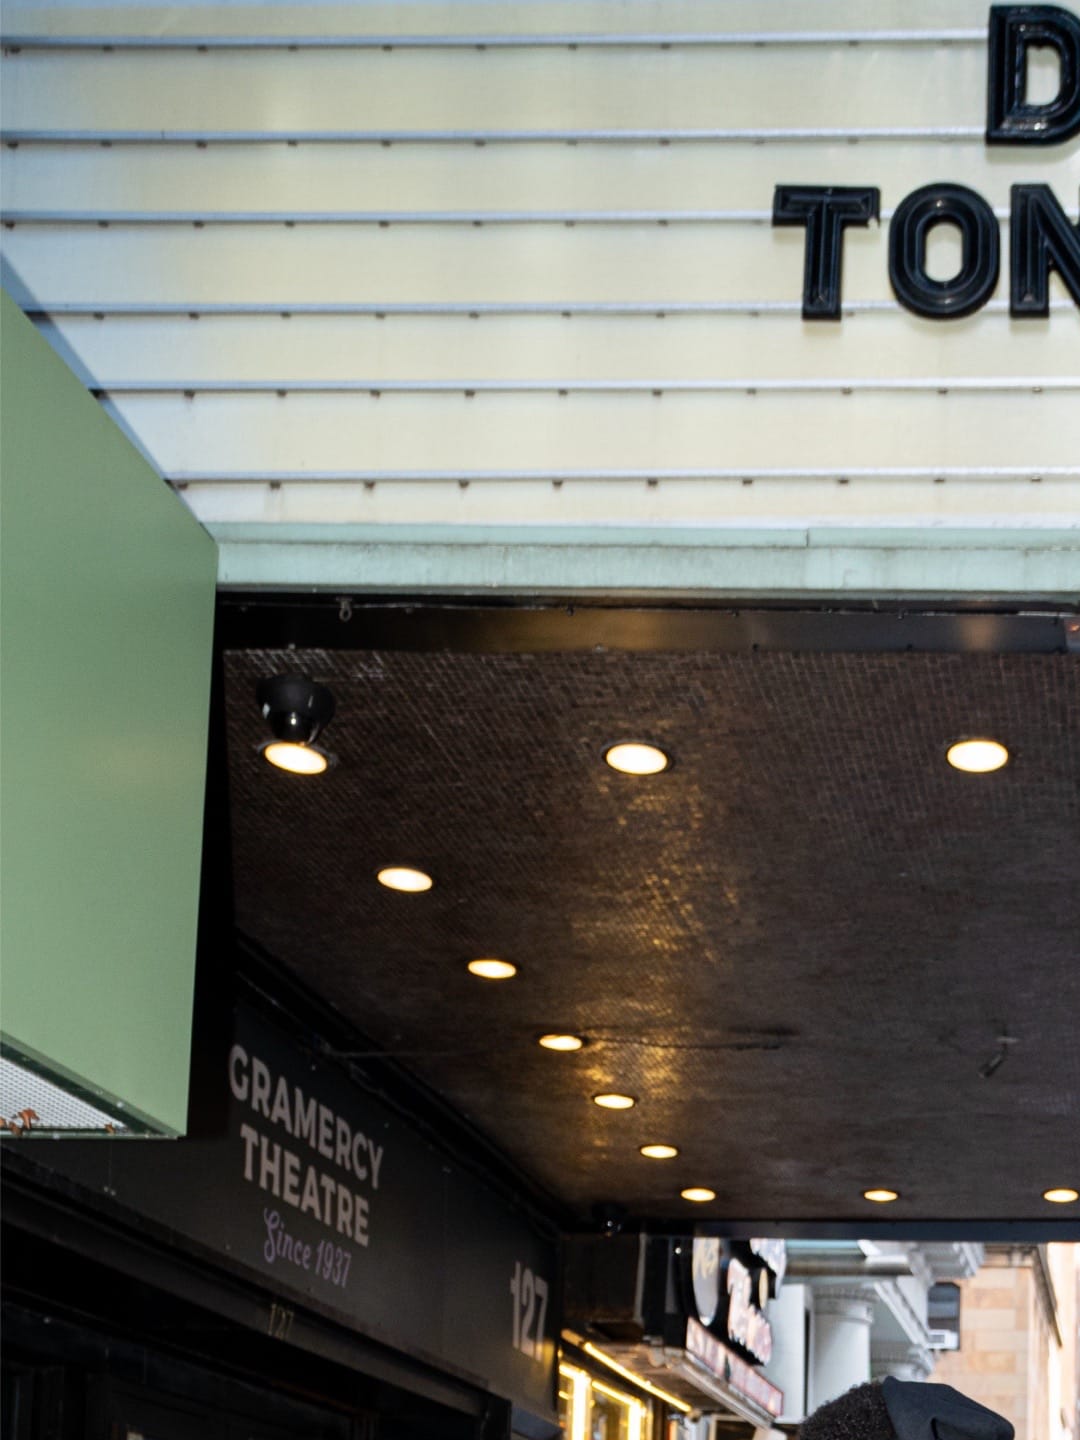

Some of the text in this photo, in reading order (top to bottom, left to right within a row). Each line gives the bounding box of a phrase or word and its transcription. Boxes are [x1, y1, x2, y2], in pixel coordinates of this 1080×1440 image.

[229, 1044, 384, 1190] GRAMERCY
[240, 1123, 370, 1248] THEATRE
[263, 1207, 352, 1289] Since 1937
[267, 1303, 294, 1341] 127
[510, 1261, 548, 1362] 127
